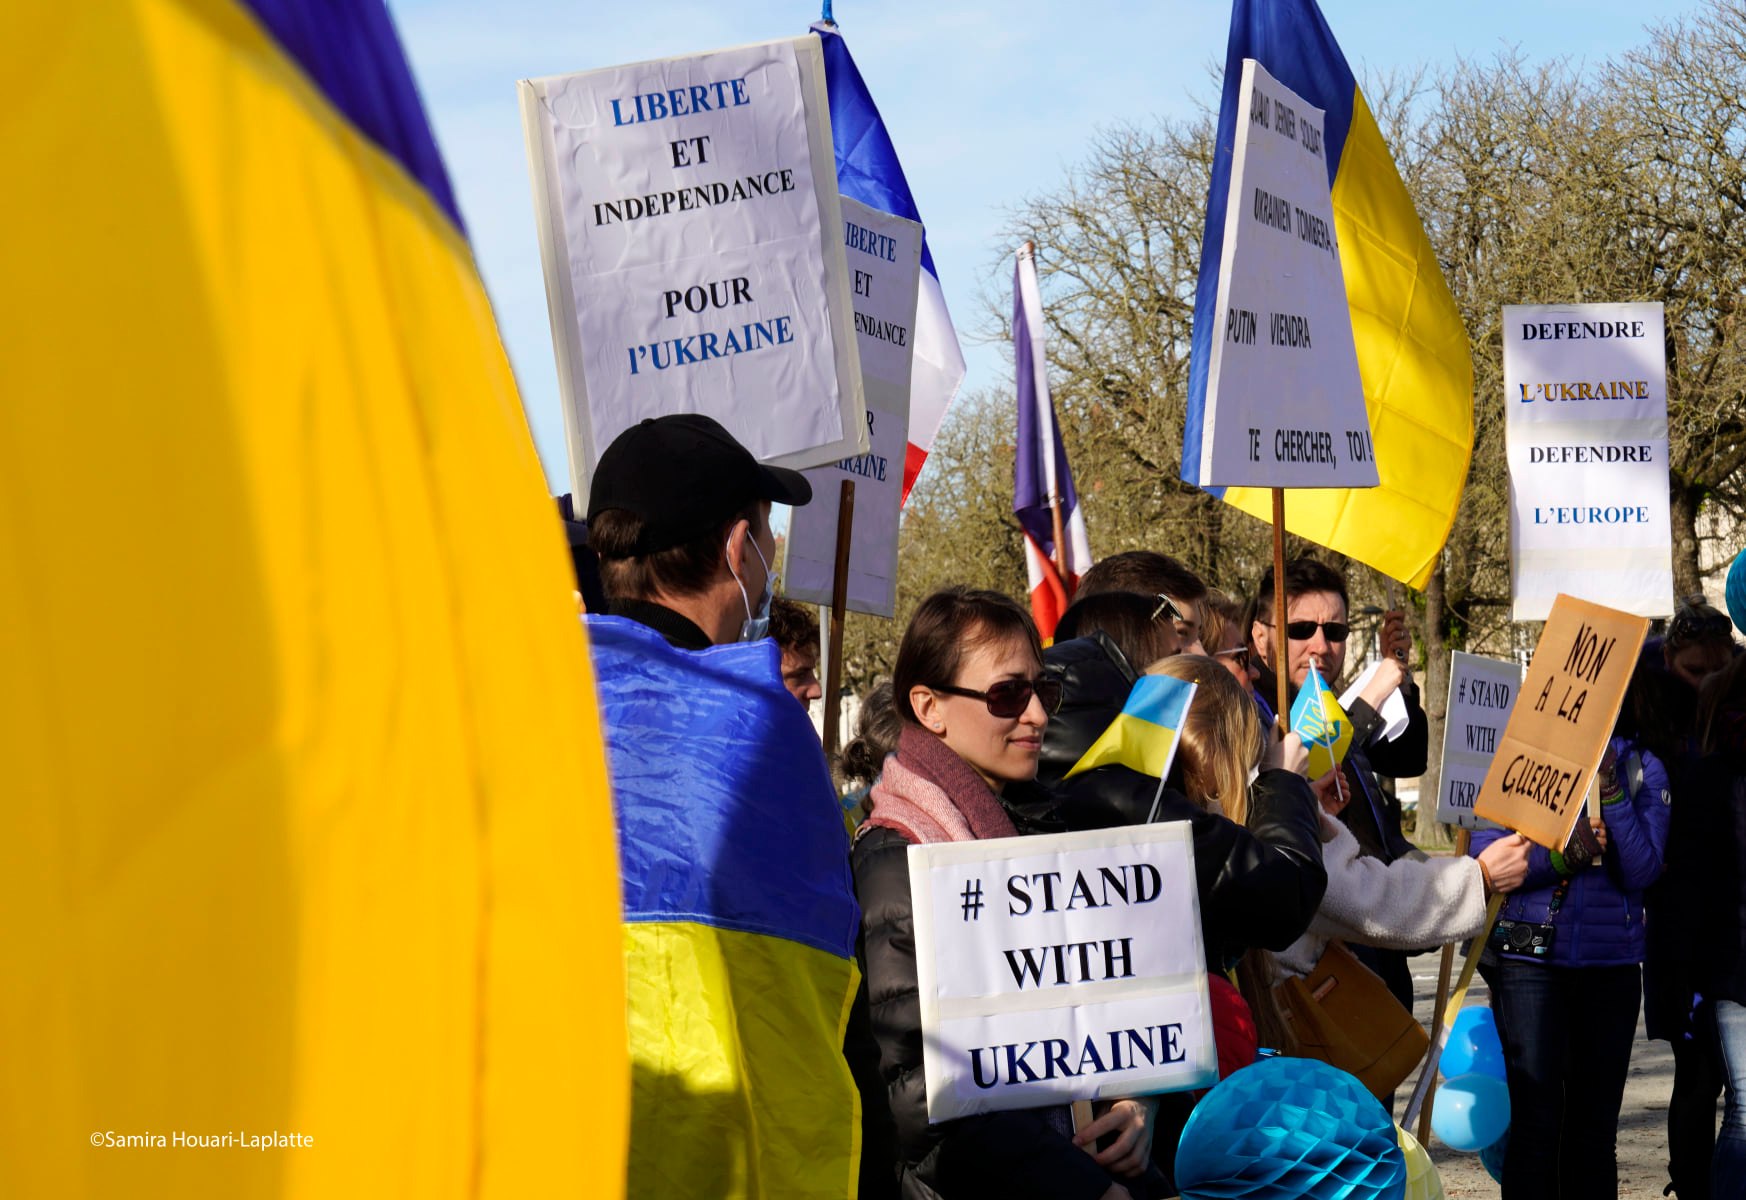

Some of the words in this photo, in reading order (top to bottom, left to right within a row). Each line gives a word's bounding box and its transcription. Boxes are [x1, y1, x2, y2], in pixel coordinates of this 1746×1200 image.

[610, 77, 750, 127] LIBERTE
[669, 135, 711, 169] ET
[593, 169, 796, 227] INDEPENDANCE
[845, 221, 896, 262] IBERTE
[663, 276, 753, 319] POUR
[854, 269, 873, 298] ET
[854, 311, 907, 347] ENDANCE
[1226, 308, 1258, 345] PUTIN
[1270, 312, 1312, 349] VIENDRA
[1522, 321, 1645, 340] DEFENDRE
[1519, 380, 1650, 403] L'UKRAINE
[1249, 428, 1261, 462] TE
[1275, 429, 1337, 470] CHERCHER,
[1530, 446, 1652, 463] DEFENDRE
[1534, 506, 1649, 524] L'EUROPE
[1563, 621, 1616, 686] NON
[1470, 679, 1510, 710] STAND
[1534, 675, 1554, 712] A
[1557, 685, 1588, 724] LA
[1466, 724, 1496, 753] WITH
[1501, 754, 1583, 817] GUERRE!
[960, 878, 985, 922] #
[1007, 863, 1162, 919] STAND
[1003, 937, 1136, 990] WITH
[968, 1022, 1186, 1089] UKRAINE
